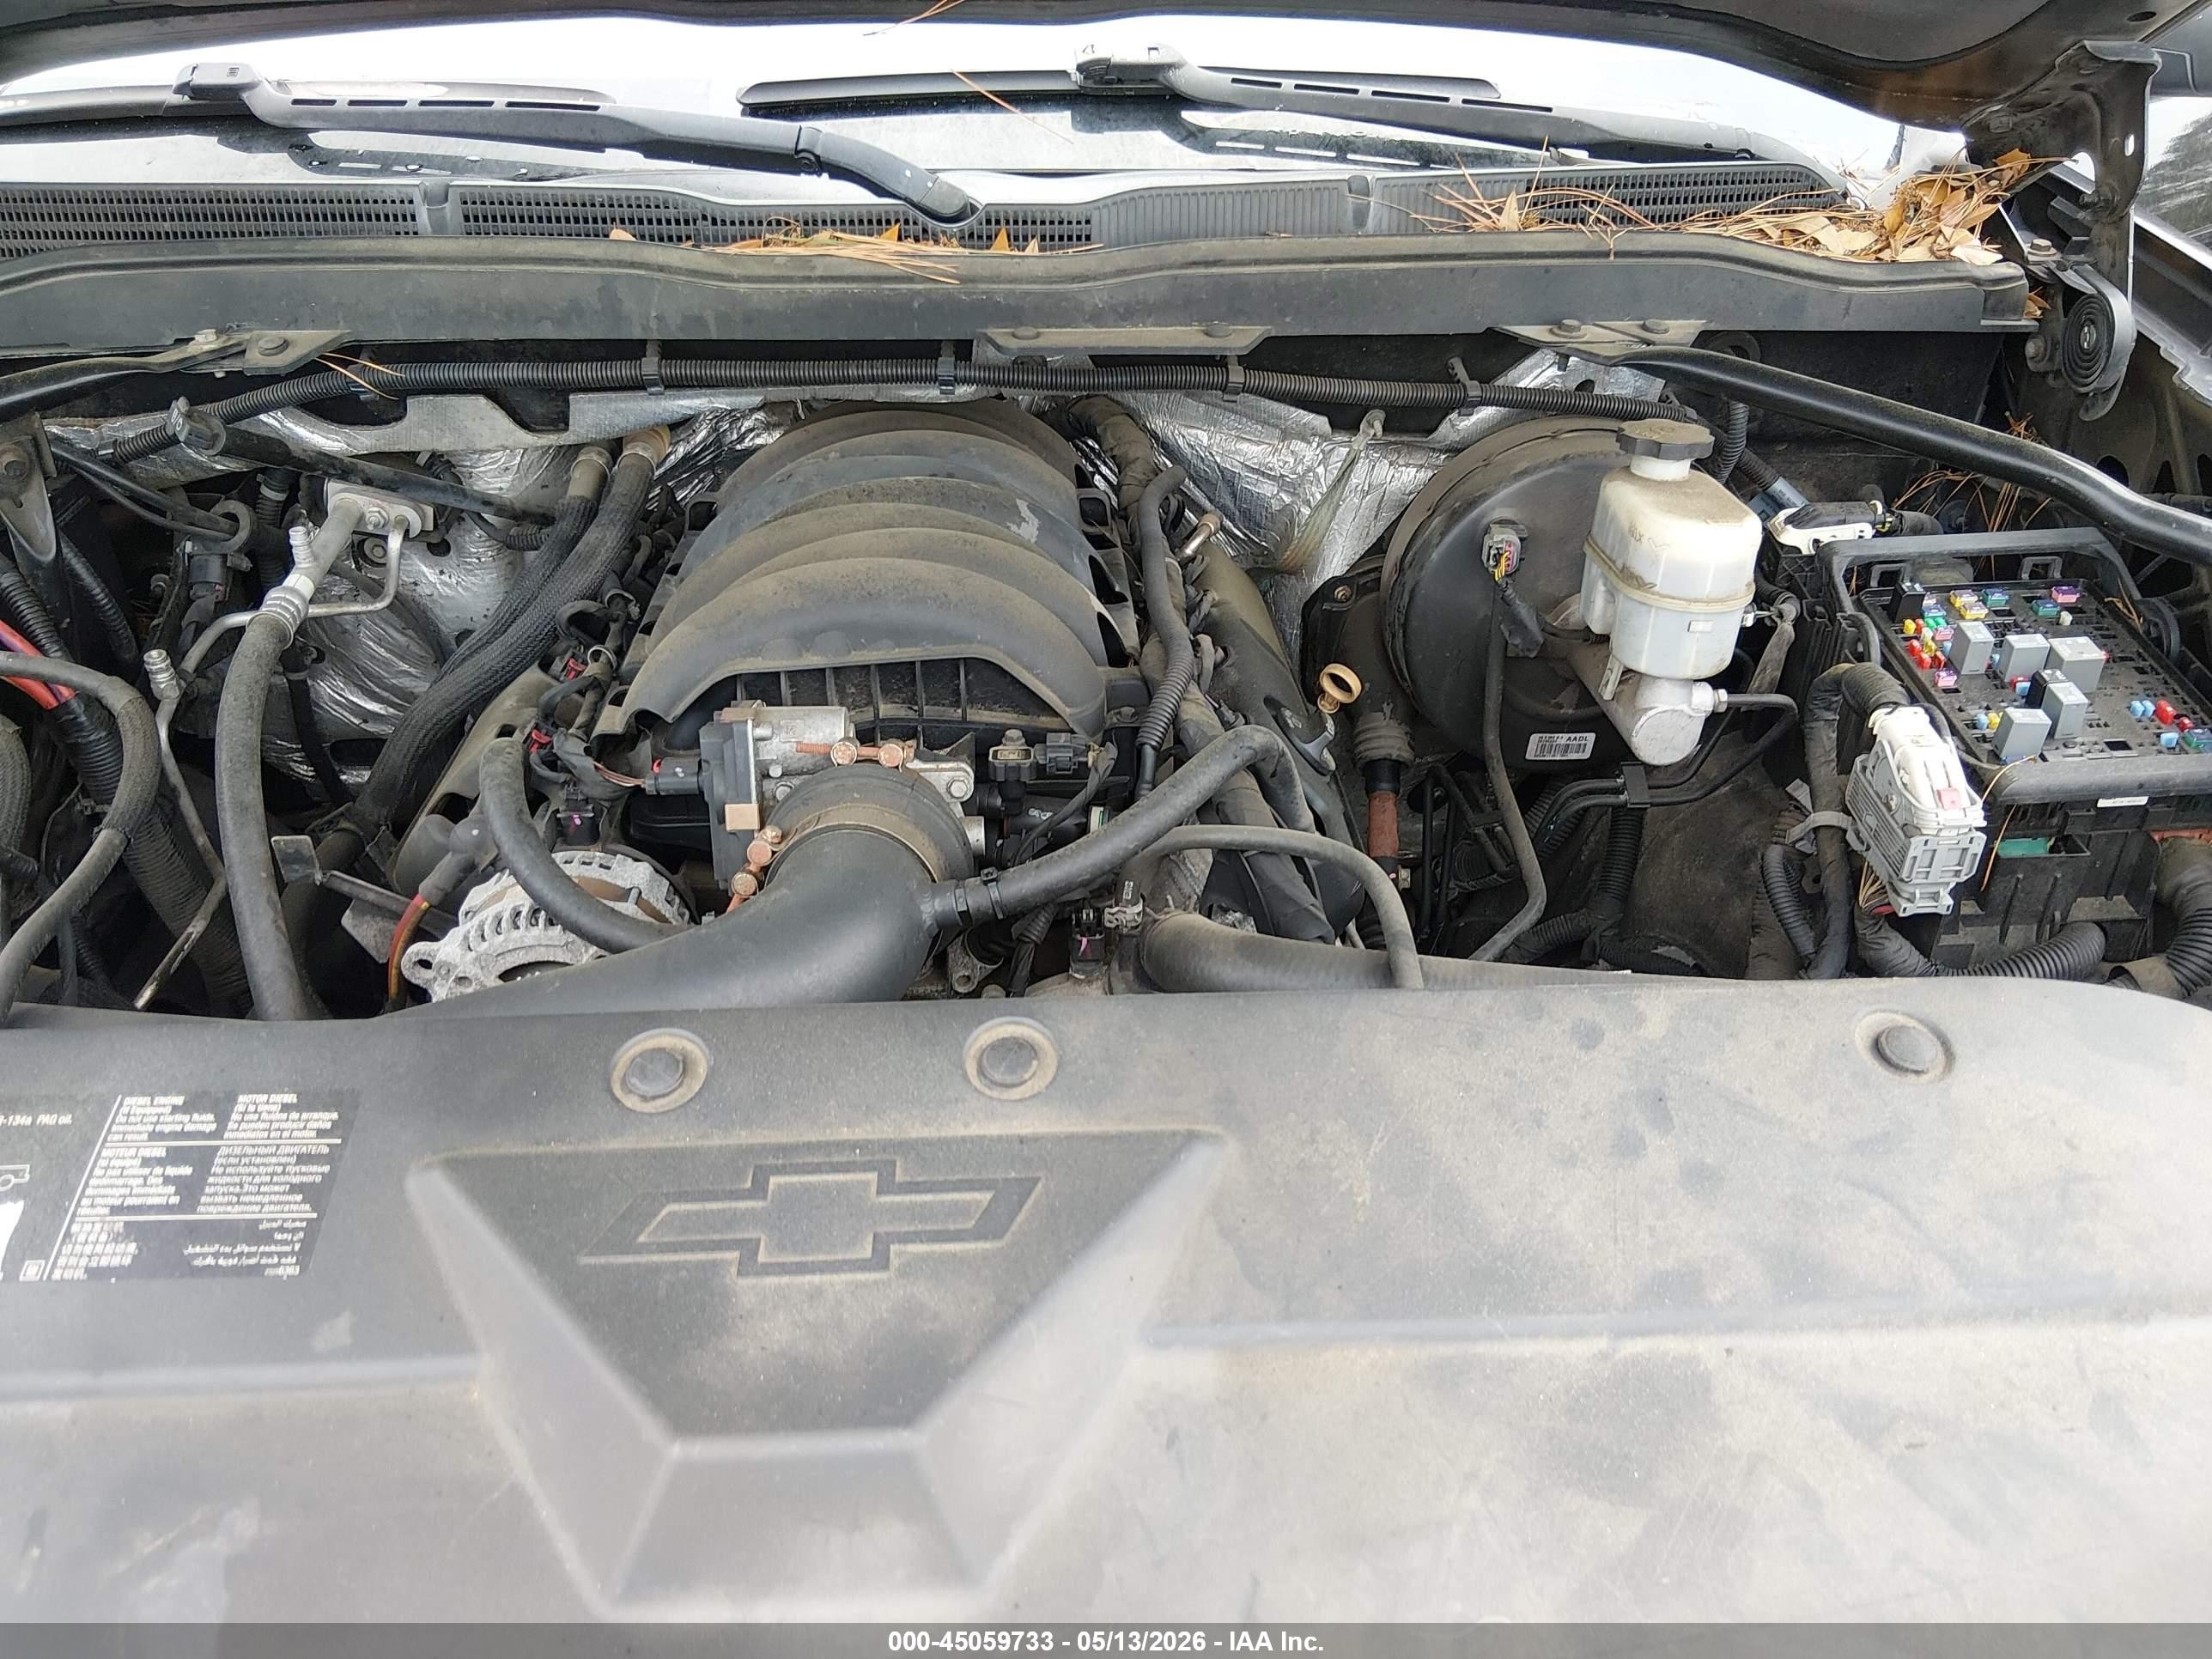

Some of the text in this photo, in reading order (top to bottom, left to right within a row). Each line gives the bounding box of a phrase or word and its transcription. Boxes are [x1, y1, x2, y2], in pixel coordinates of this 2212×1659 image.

[153, 1095, 185, 1106] ENGINE
[237, 1094, 298, 1103] MOTOR DIESEL
[158, 1114, 190, 1124] starting
[155, 1124, 183, 1133] engine
[183, 1122, 217, 1133] damage
[270, 1121, 307, 1131] producir
[269, 1130, 281, 1139] en
[281, 1130, 291, 1138] el
[101, 1147, 137, 1158] MOTEUR
[217, 1145, 329, 1156] ДИЗЕЛЬНЫЙ ДВИГАТЕЛЬ
[240, 1155, 297, 1165] установлен)
[211, 1164, 330, 1175] Не используйте пусковые
[207, 1174, 322, 1185] жидкости для холодного
[259, 1184, 290, 1193] может
